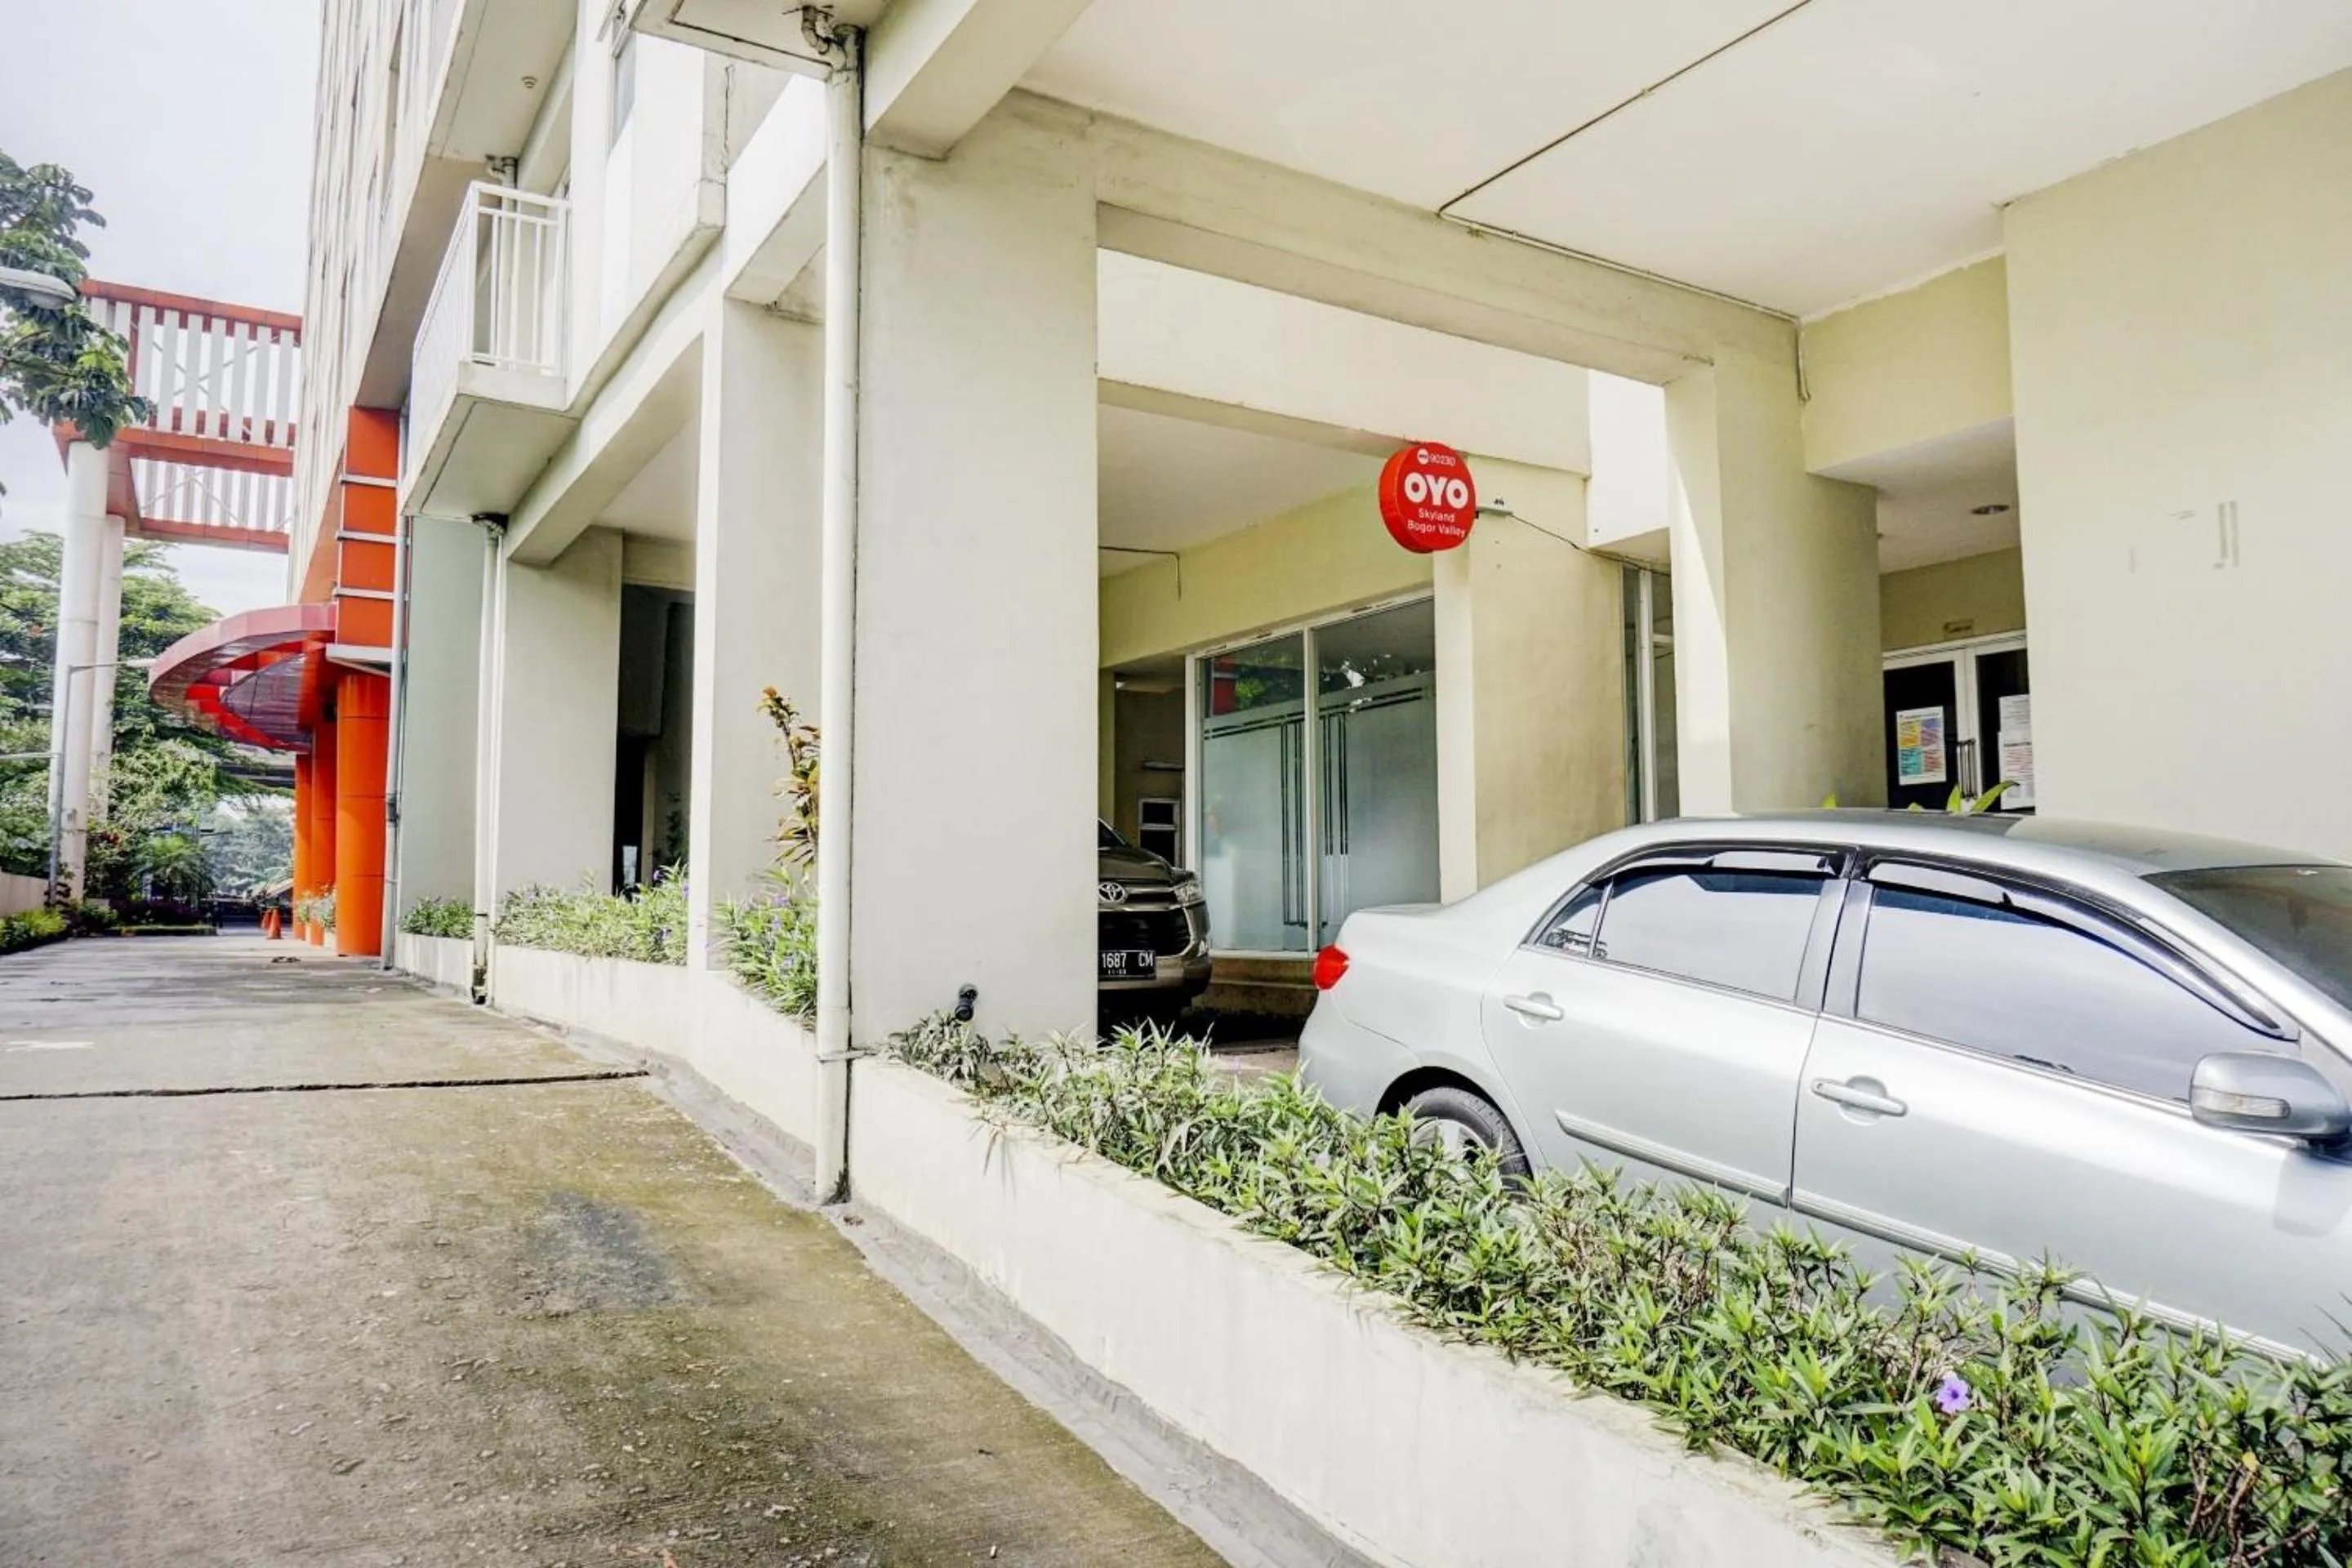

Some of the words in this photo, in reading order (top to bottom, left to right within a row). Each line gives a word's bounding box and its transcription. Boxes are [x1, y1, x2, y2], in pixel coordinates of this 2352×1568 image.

[1405, 472, 1468, 509] OYO
[1419, 508, 1455, 523] Skyland
[1407, 519, 1436, 533] Bogor
[1438, 524, 1465, 538] Valley
[1102, 953, 1126, 968] 1687
[1138, 952, 1153, 967] CM
